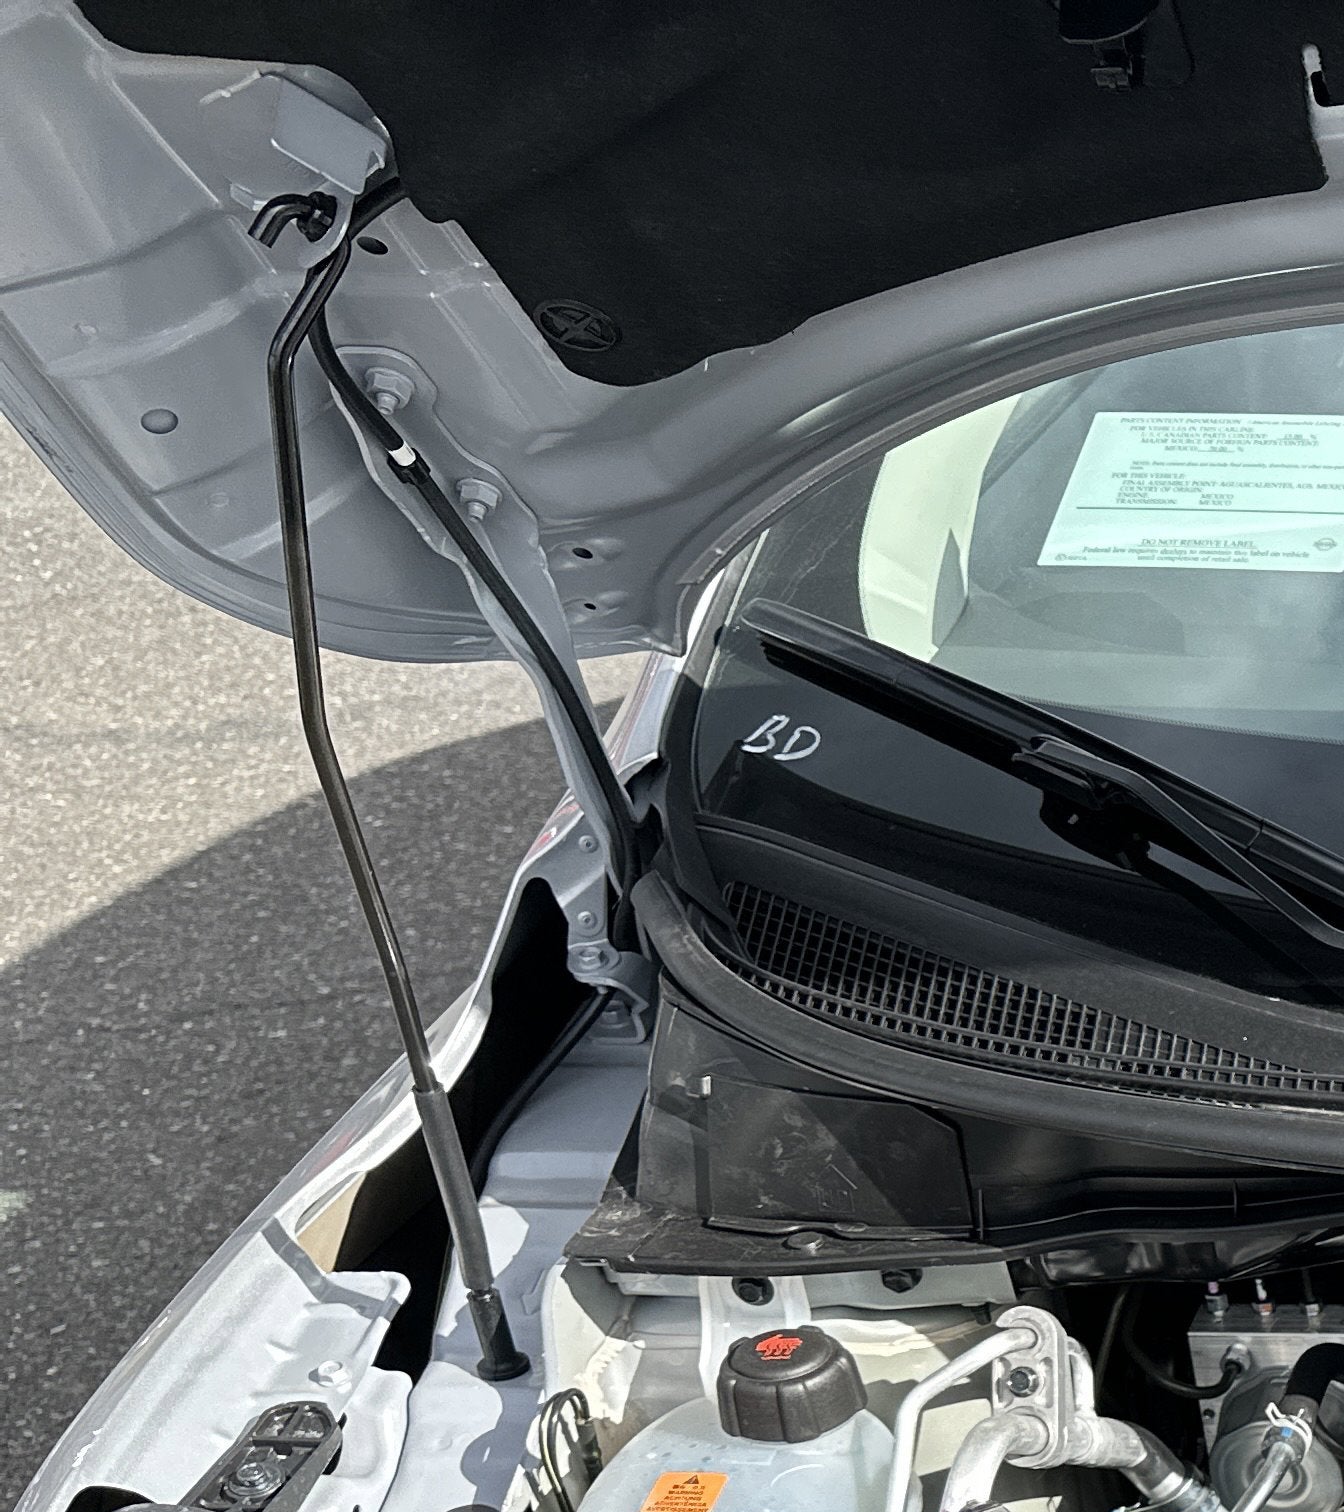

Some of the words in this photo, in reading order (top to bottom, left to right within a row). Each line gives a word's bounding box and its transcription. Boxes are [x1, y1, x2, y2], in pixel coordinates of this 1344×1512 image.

[1180, 539, 1222, 547] REMOVE
[1224, 540, 1256, 548] LABEL
[740, 715, 821, 761] BD
